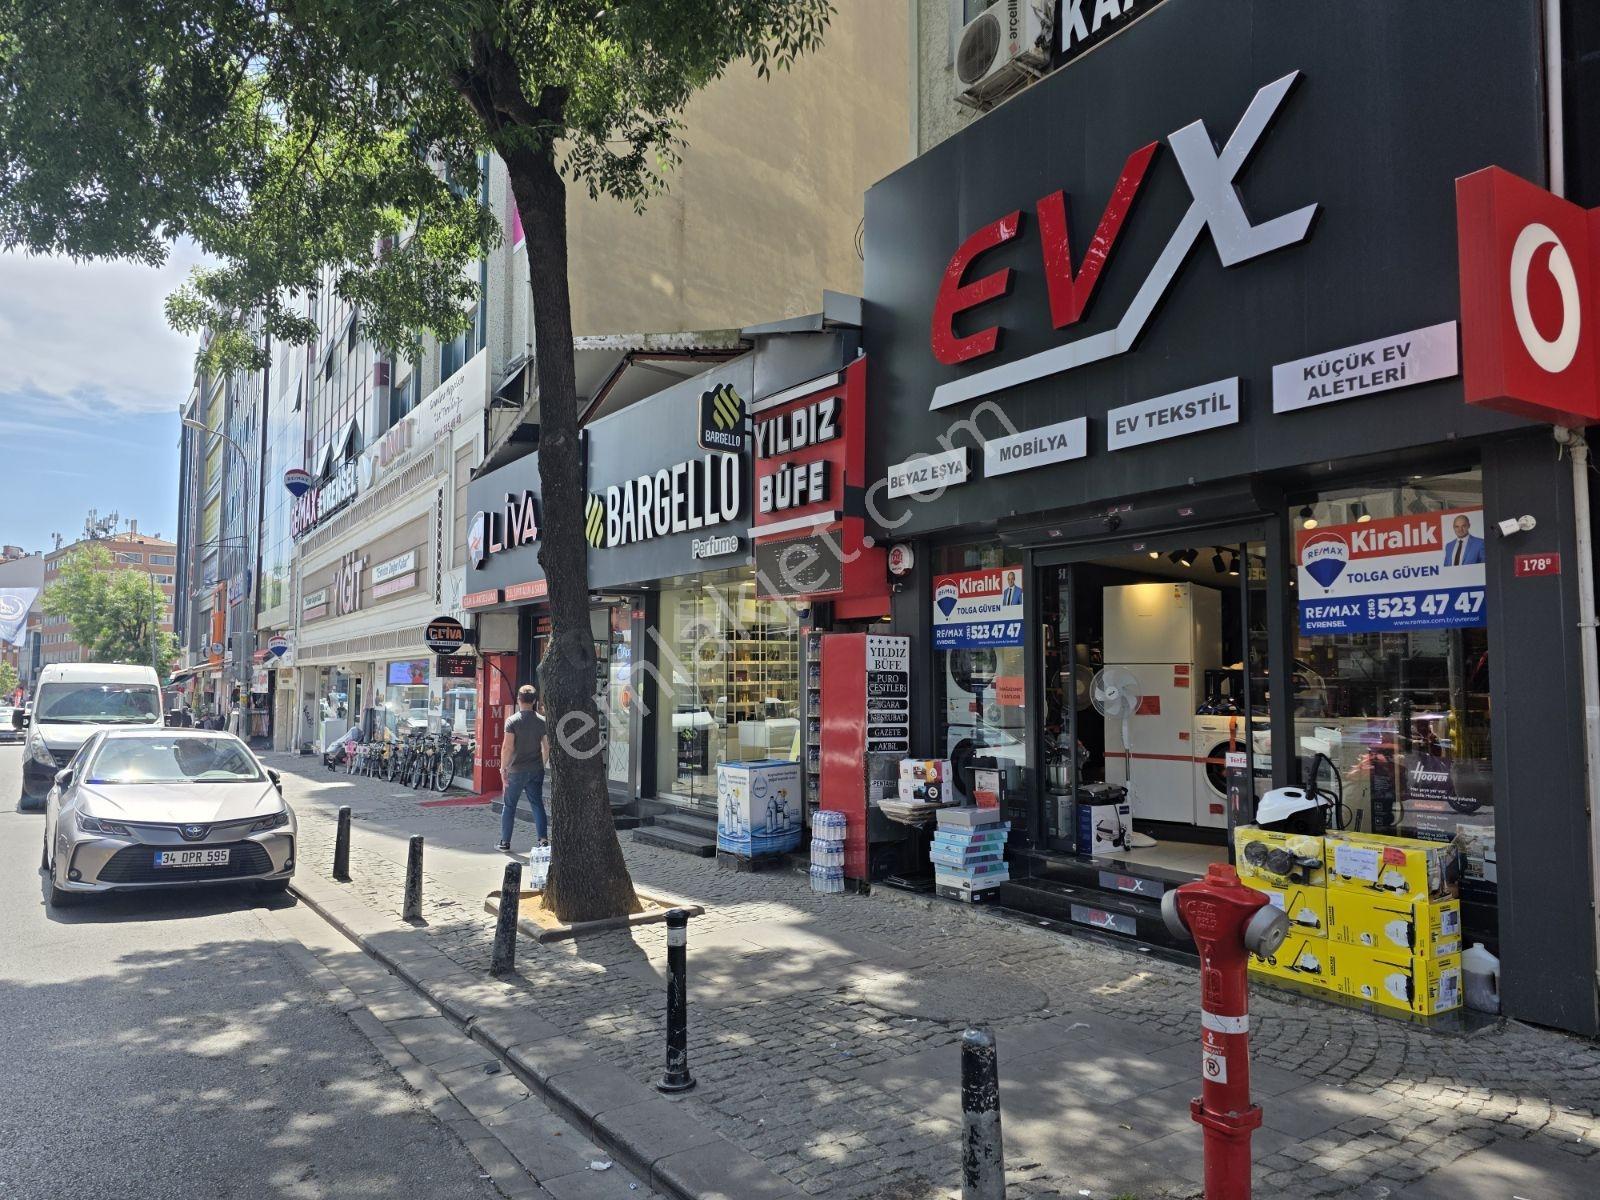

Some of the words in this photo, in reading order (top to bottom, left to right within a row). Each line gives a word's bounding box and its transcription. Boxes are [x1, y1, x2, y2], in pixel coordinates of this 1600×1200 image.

[930, 70, 1318, 411] EVX
[1303, 350, 1376, 381] KÜÇÜK
[1383, 342, 1411, 362] EV
[1307, 362, 1406, 401] ALETLERİ
[1115, 415, 1140, 436] EV
[1145, 392, 1232, 428] TEKSTİL
[754, 396, 838, 459] YILDIZ
[705, 430, 741, 447] BARGELLO
[999, 433, 1068, 462] MOBİLYA
[890, 468, 928, 489] BEYAZ
[931, 460, 964, 482] EŞYA
[606, 452, 740, 548] BARGELLO
[1351, 521, 1438, 553] Kiralık
[692, 535, 739, 560] Perfume
[1307, 546, 1343, 559] RE/MAX
[959, 574, 1001, 594] Kiralık
[1347, 569, 1390, 584] TOLGA
[1392, 564, 1440, 579] GÜVEN
[956, 607, 978, 615] TOLGA
[978, 604, 1001, 613] GÜVEN
[1305, 603, 1361, 619] RE/MAX
[1377, 596, 1416, 618] 523
[1420, 593, 1449, 615] 47
[1454, 590, 1485, 613] 47
[936, 628, 964, 638] RE/MAX
[971, 624, 990, 639] 523
[991, 623, 1005, 638] 47
[1006, 622, 1021, 638] 47
[1306, 620, 1347, 629] EVRENSEL
[869, 647, 907, 658] YILDIZ
[874, 657, 902, 671] BÜFE
[877, 674, 899, 683] PURO
[163, 852, 176, 864] 34
[182, 851, 203, 863] DPR
[206, 850, 227, 862] 595
